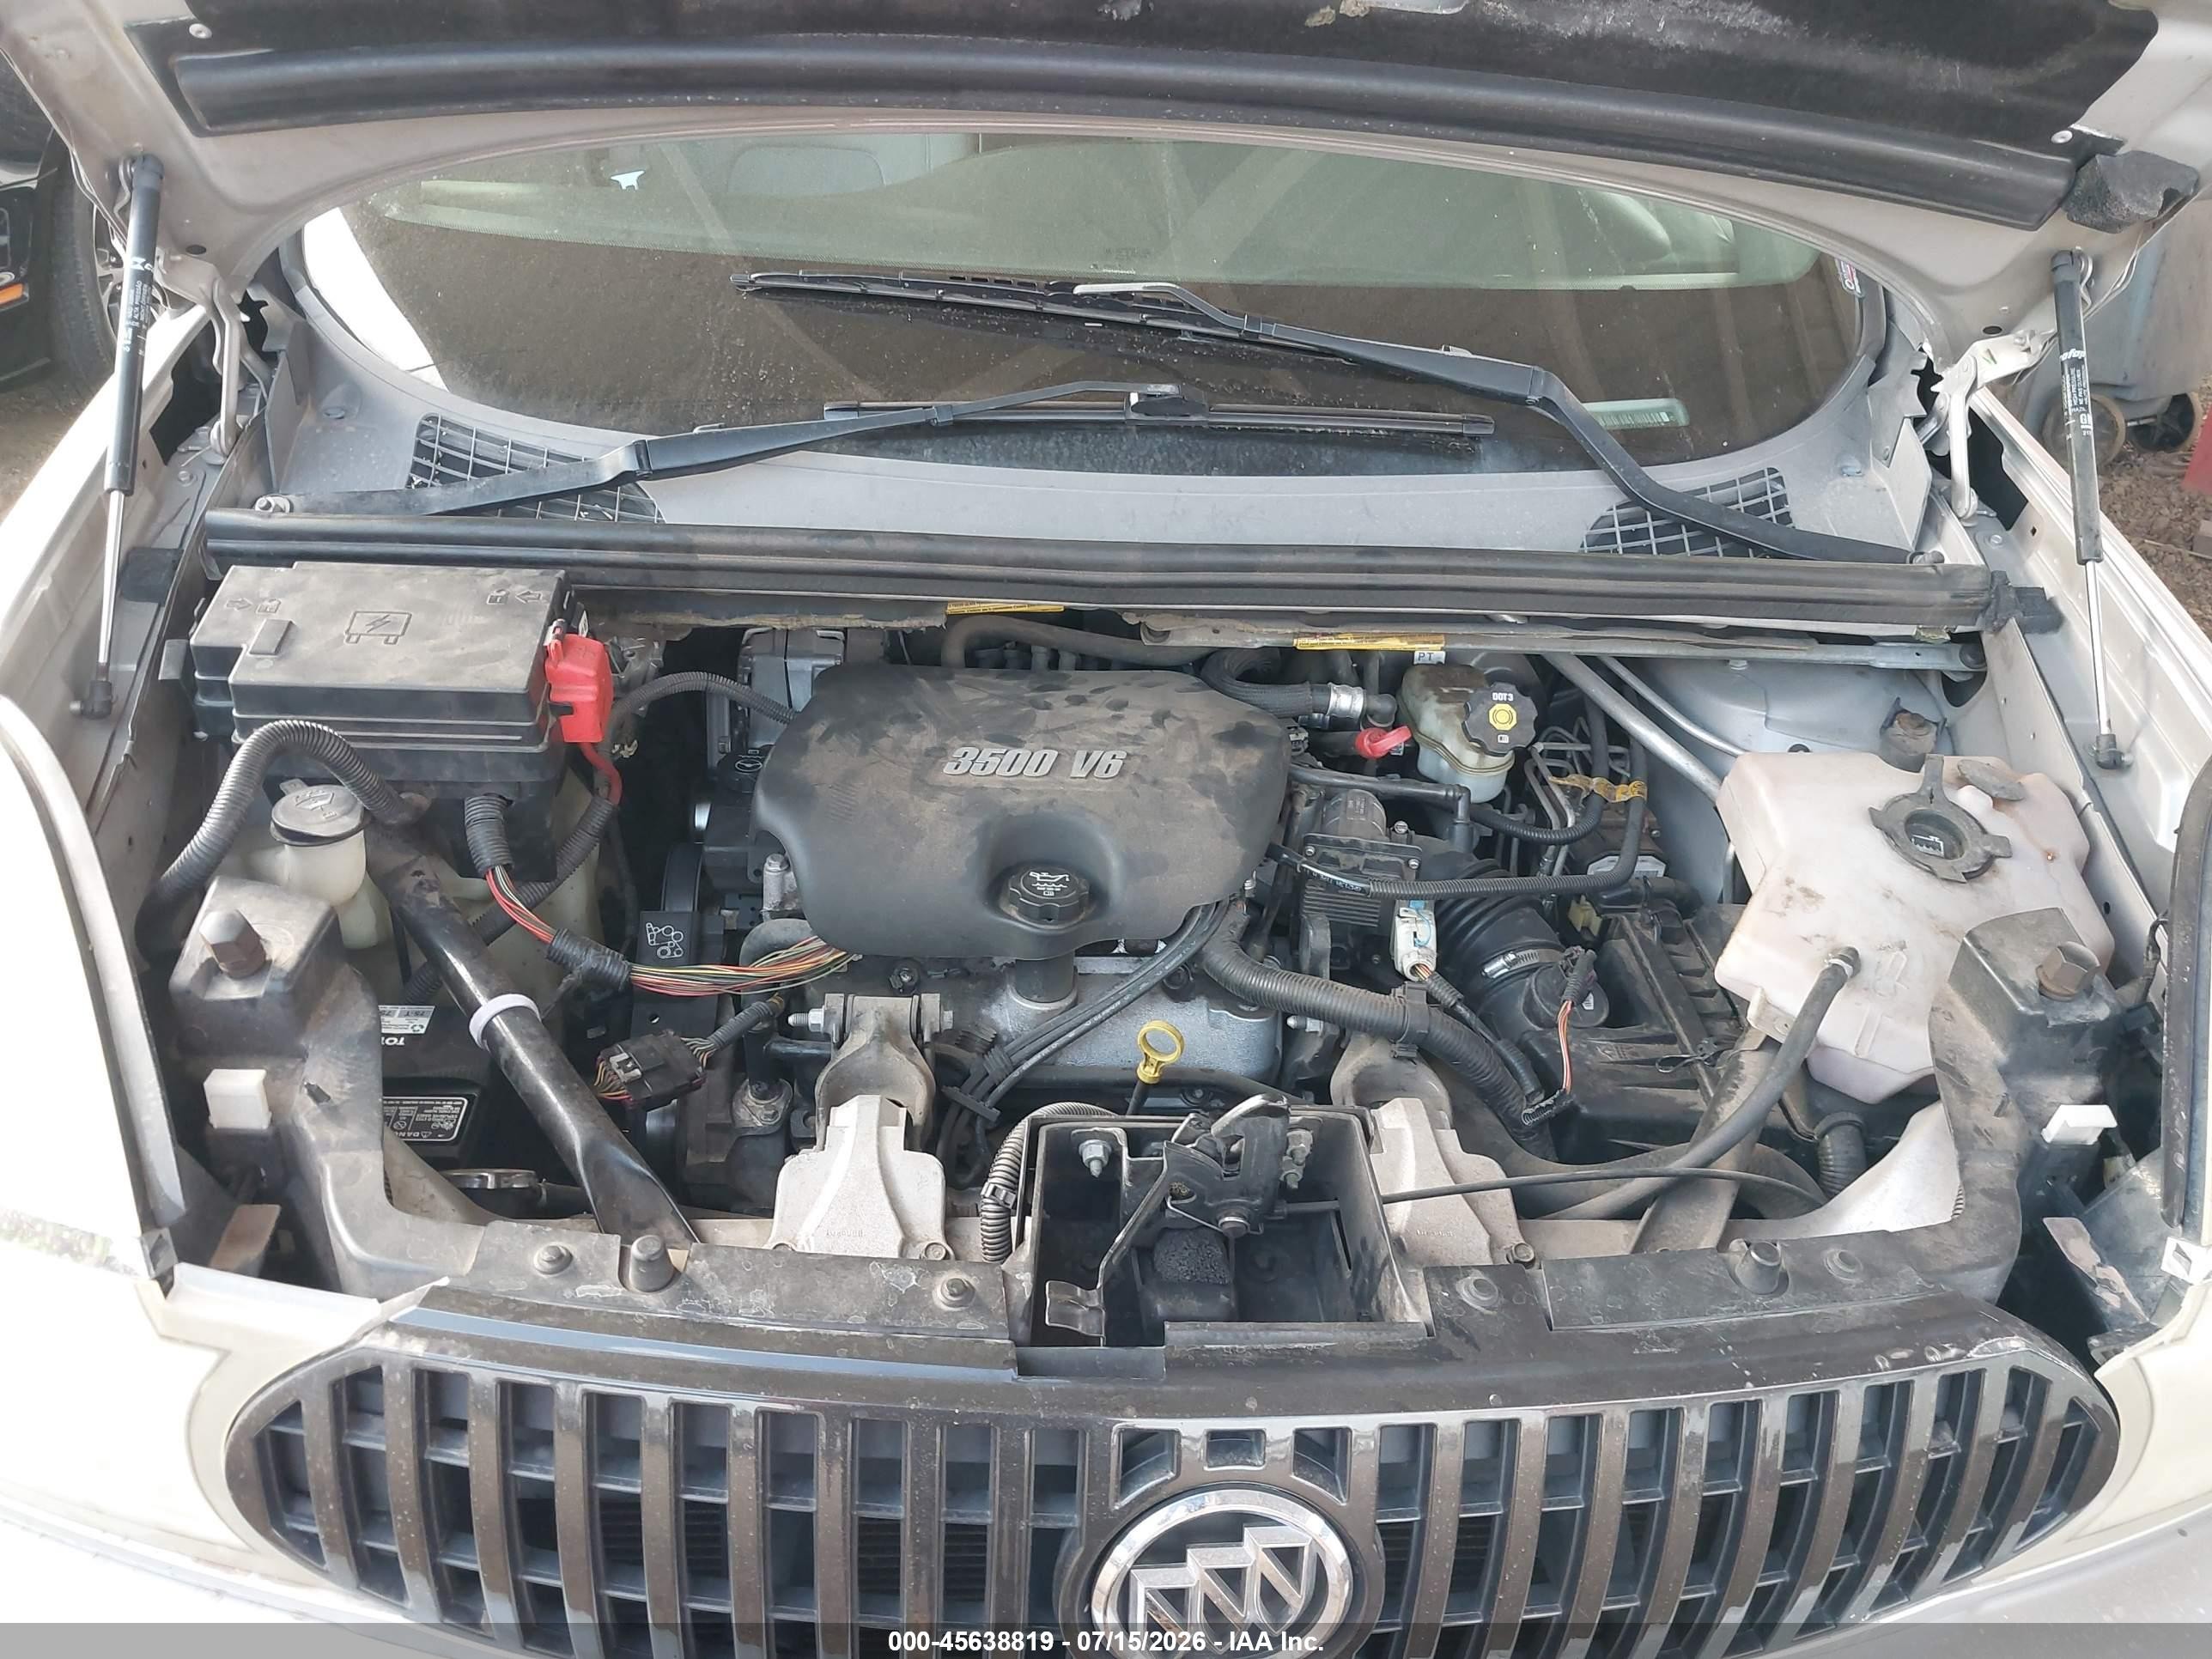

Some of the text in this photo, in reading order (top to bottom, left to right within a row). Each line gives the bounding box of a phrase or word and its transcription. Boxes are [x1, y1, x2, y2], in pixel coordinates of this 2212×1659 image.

[1492, 692, 1514, 702] DOT3
[943, 746, 1127, 779] 3500 V6
